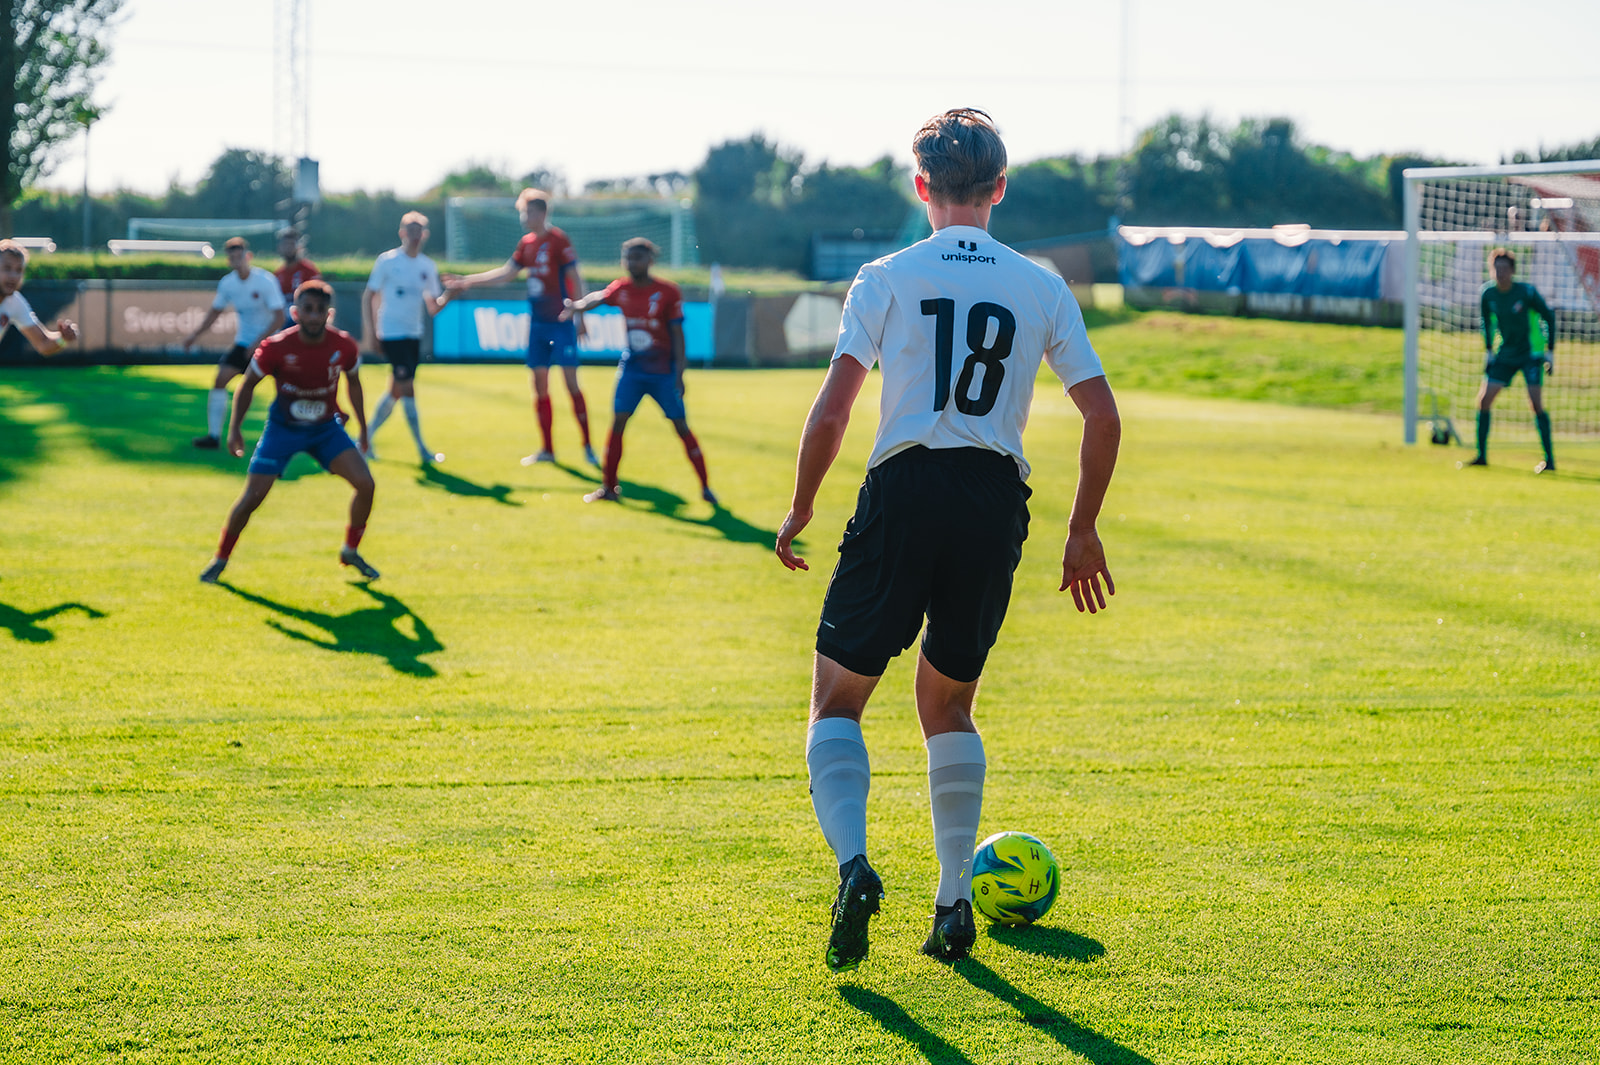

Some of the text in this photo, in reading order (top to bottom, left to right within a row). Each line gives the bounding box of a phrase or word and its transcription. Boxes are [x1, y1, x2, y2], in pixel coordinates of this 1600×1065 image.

[941, 253, 997, 265] unisport
[123, 306, 236, 334] Swedban
[920, 297, 1017, 417] 18
[1028, 878, 1041, 895] H
